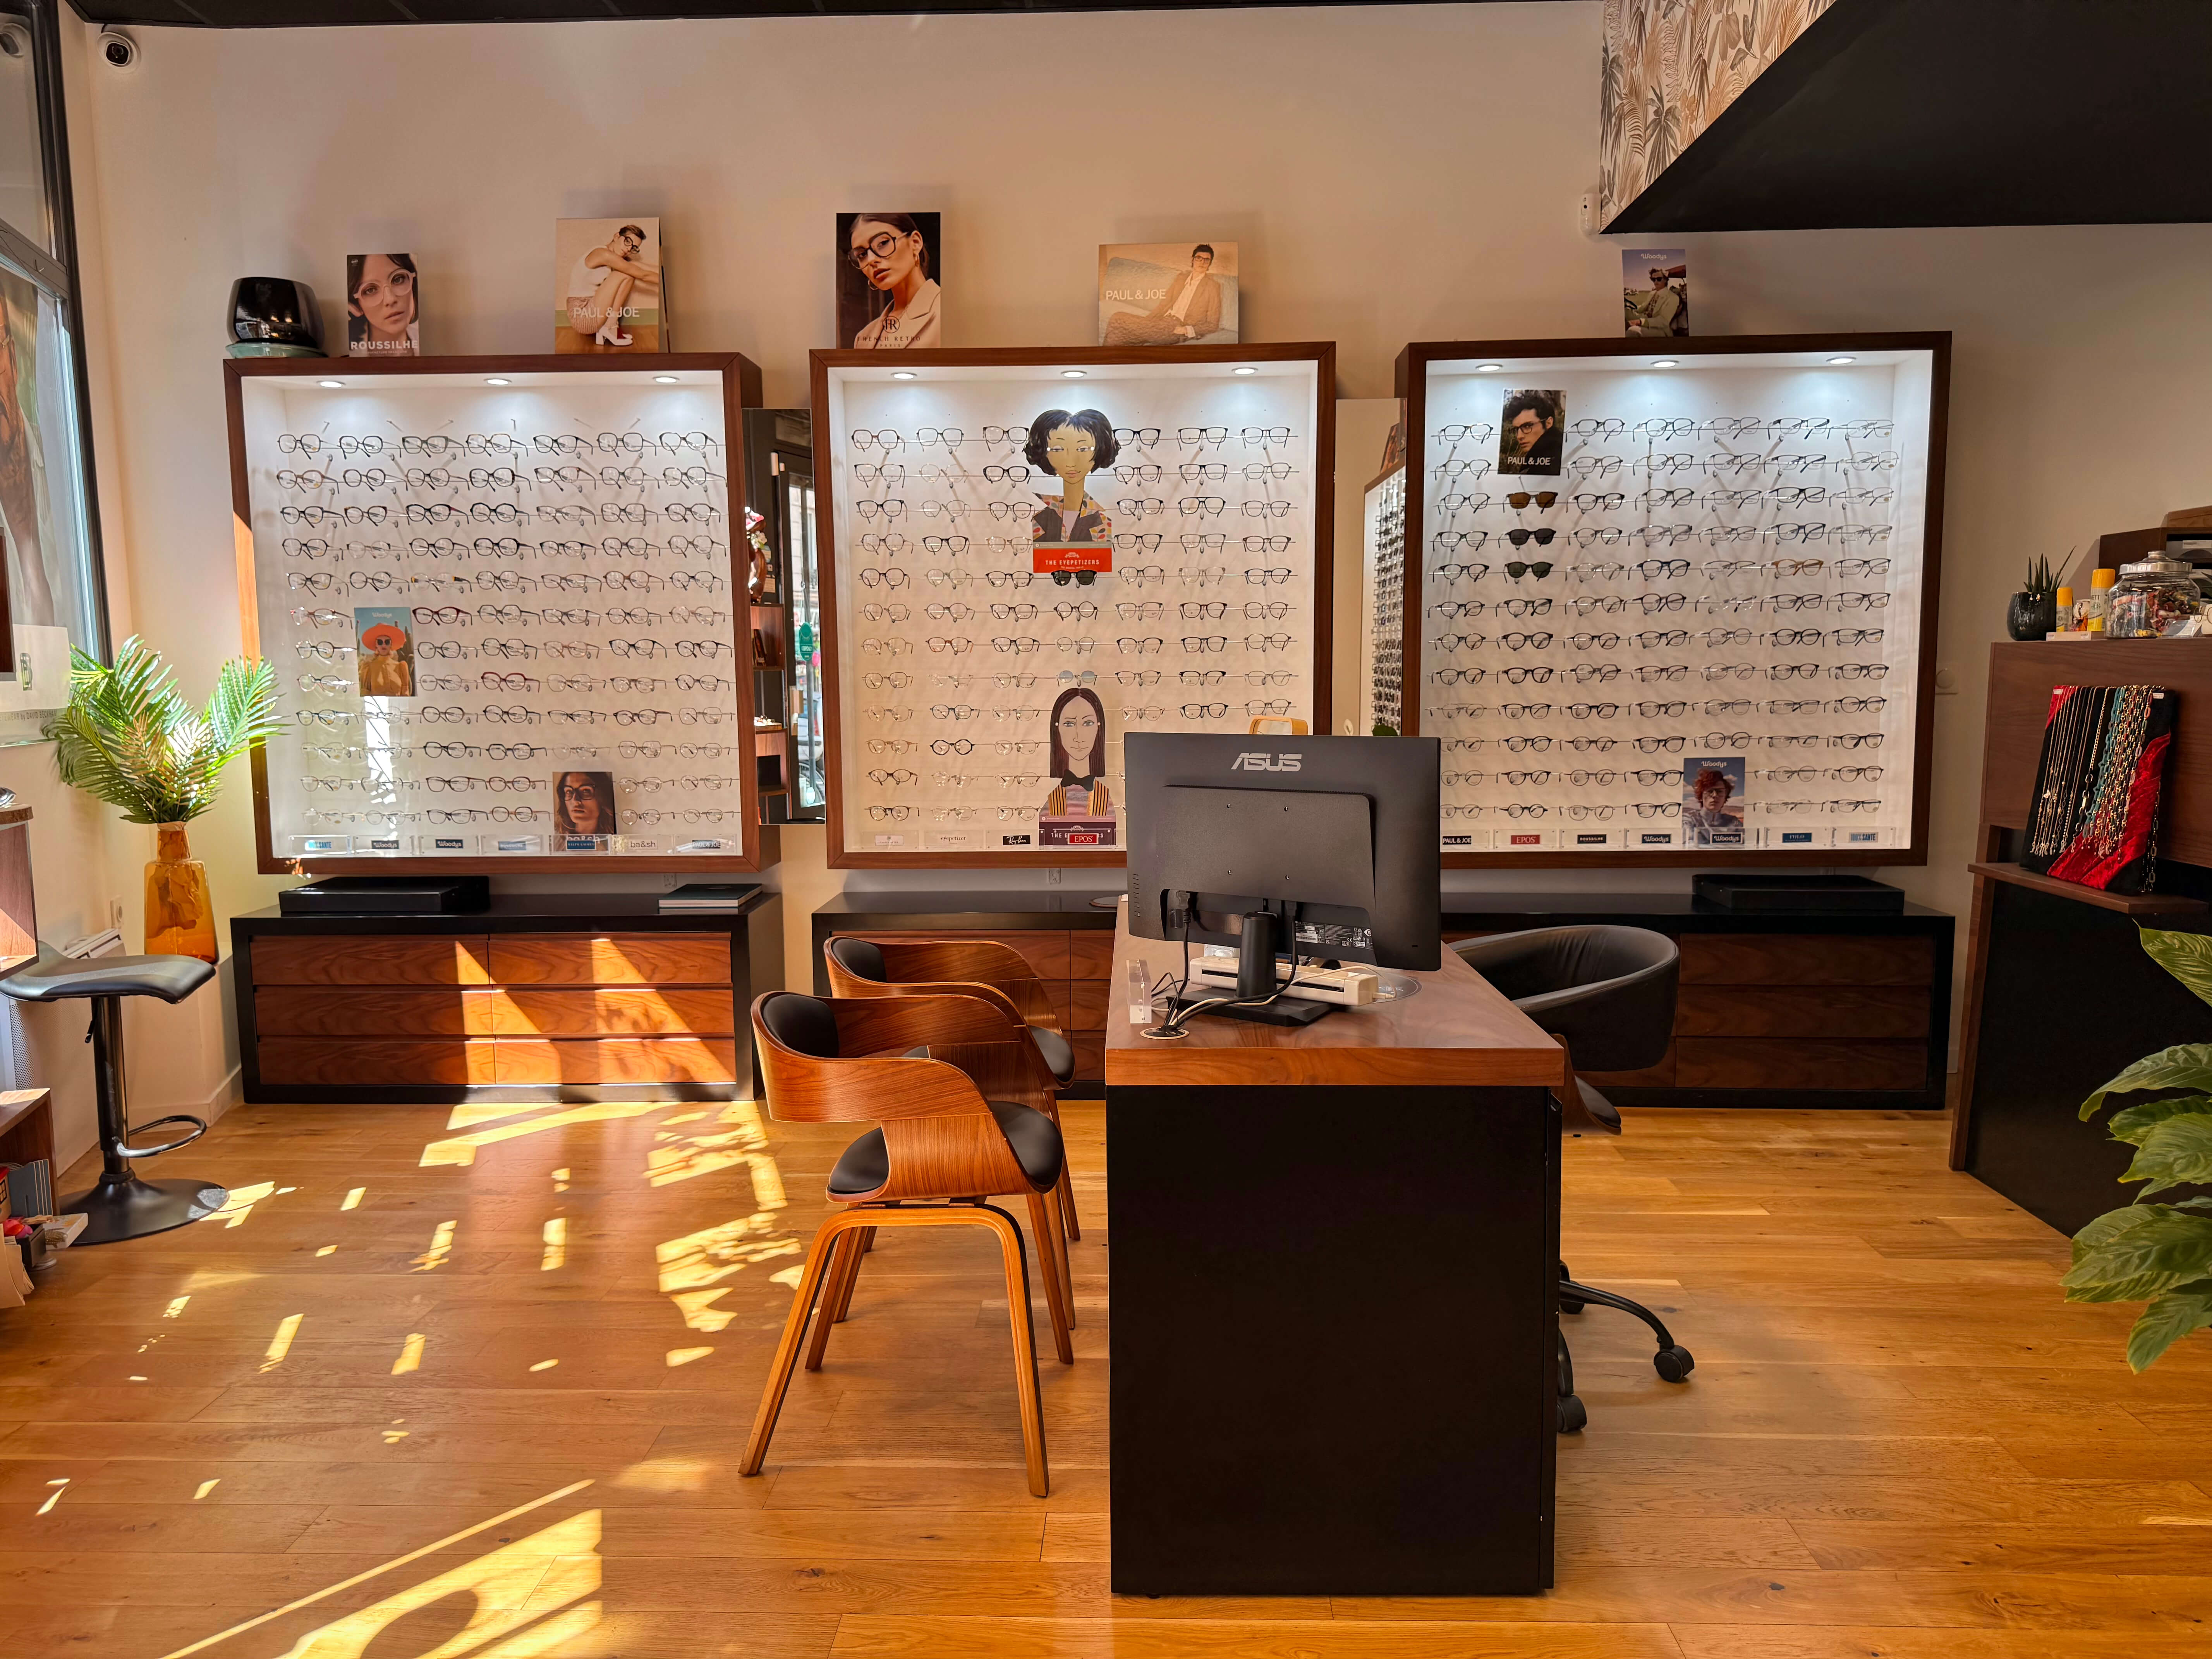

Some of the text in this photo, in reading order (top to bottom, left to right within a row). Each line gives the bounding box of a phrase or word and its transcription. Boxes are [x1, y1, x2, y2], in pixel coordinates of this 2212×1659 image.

[1106, 289, 1166, 301] PAUL & JOE
[573, 306, 640, 318] PAUL & JOE
[350, 340, 419, 350] ROUSSILHE
[1508, 457, 1527, 465] PAUL
[1231, 753, 1302, 771] ASUS
[1006, 836, 1026, 845] Ray-Ban
